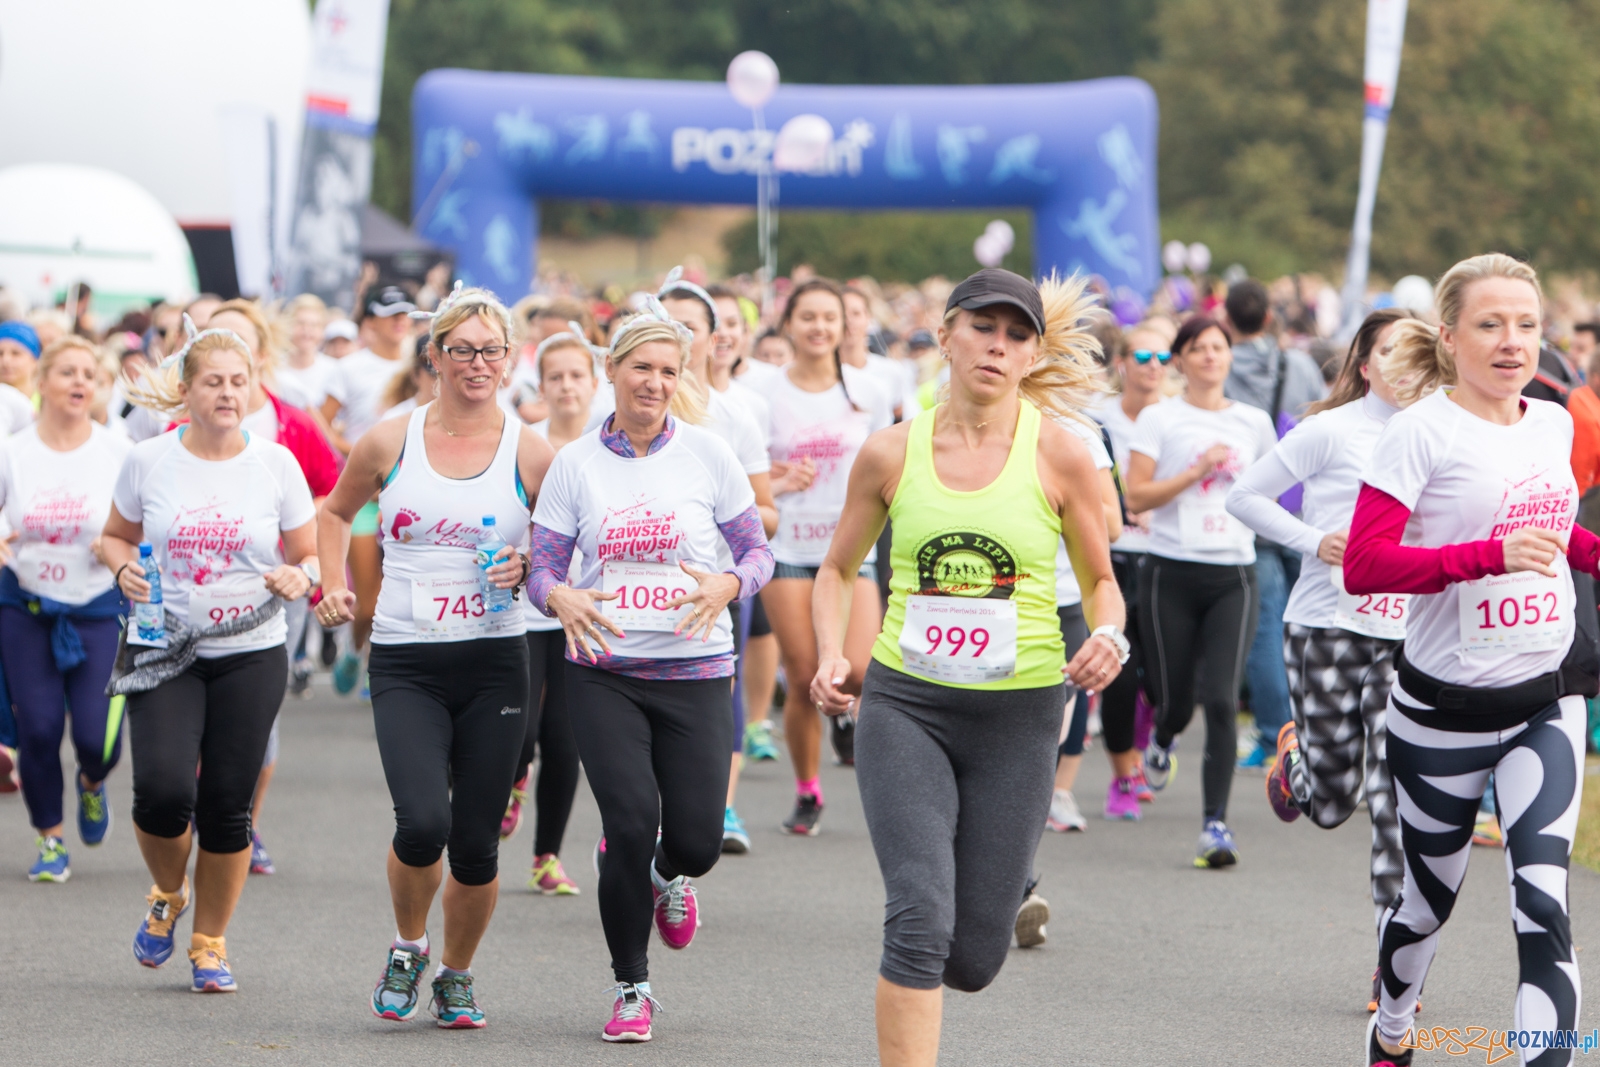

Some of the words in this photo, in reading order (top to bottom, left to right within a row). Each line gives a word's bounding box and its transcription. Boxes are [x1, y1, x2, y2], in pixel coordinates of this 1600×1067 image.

[1507, 499, 1569, 519] zawsze
[177, 525, 239, 538] zawsze
[606, 523, 671, 541] zawsze
[171, 551, 193, 560] 2016
[940, 535, 965, 547] MA
[972, 537, 1010, 563] LIPY
[38, 561, 66, 584] 20
[433, 592, 485, 621] 743
[613, 585, 687, 611] 1089
[1356, 593, 1405, 619] 245
[1476, 591, 1560, 629] 1052
[979, 608, 997, 616] 2016
[925, 625, 990, 657] 999
